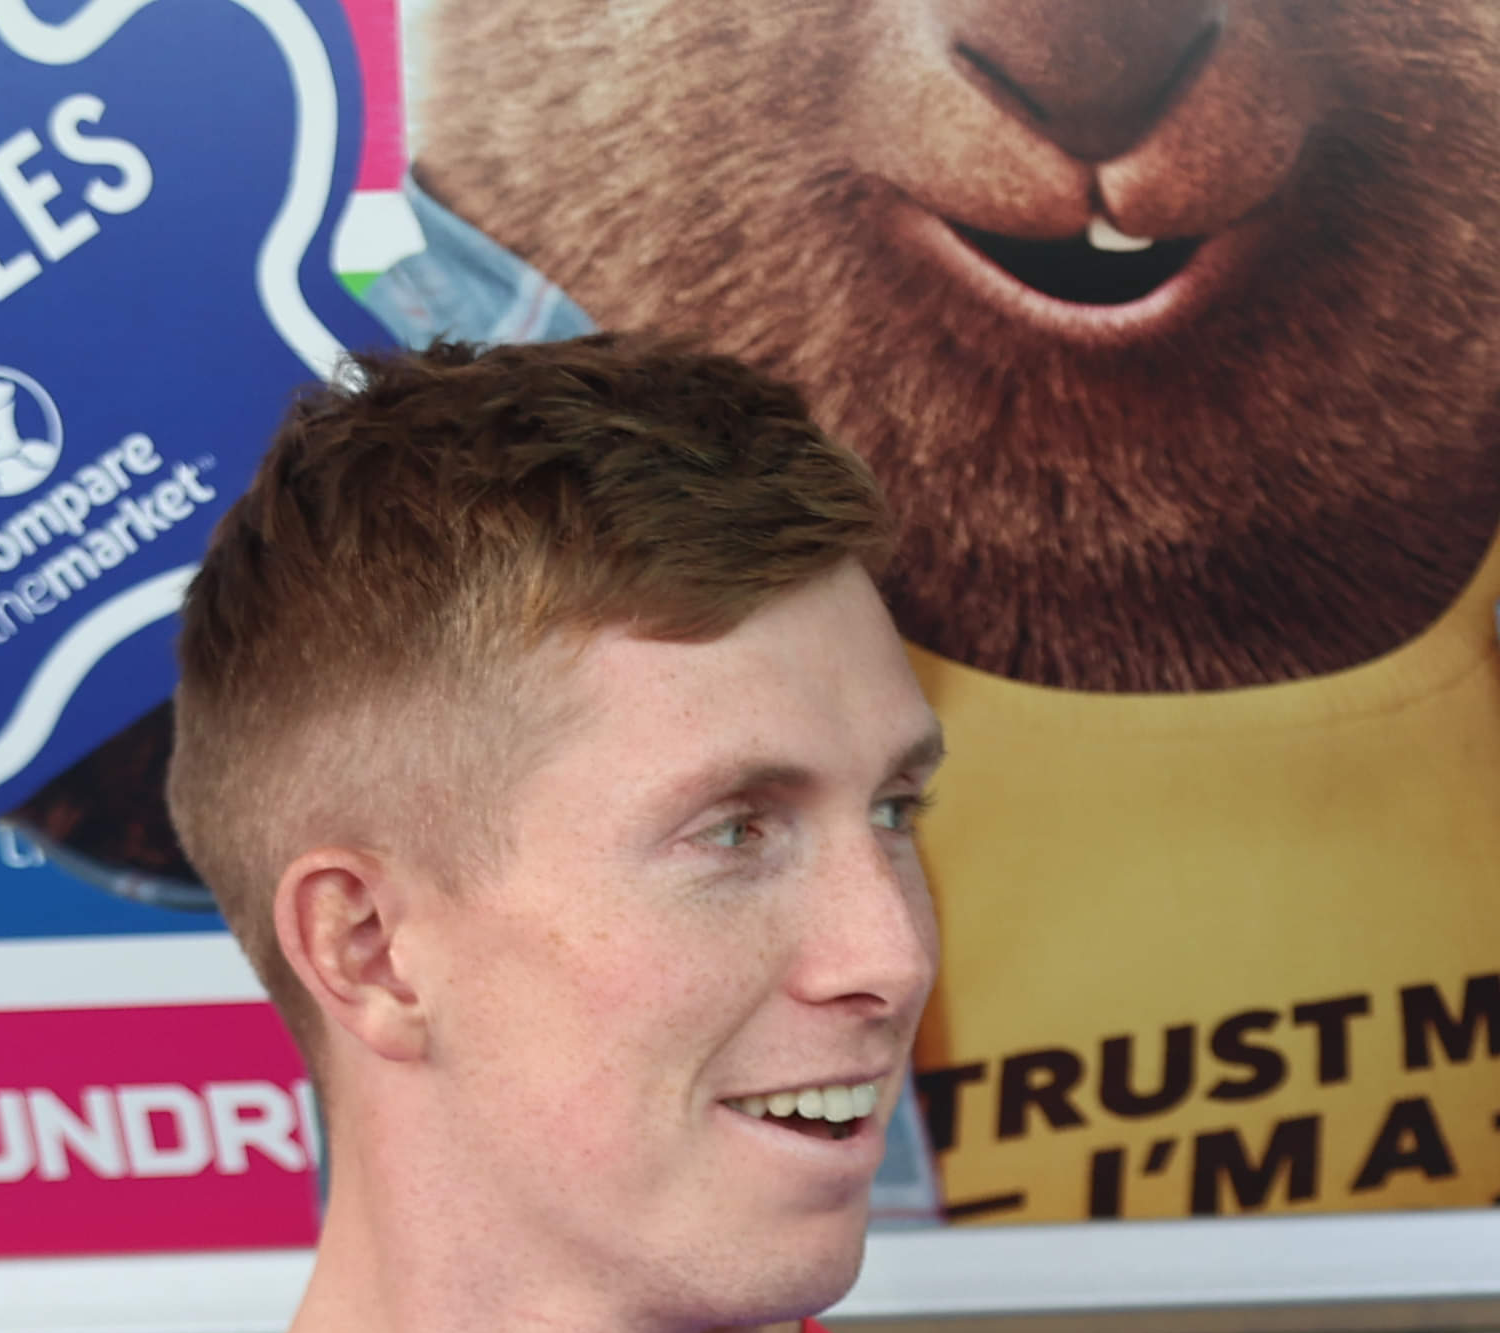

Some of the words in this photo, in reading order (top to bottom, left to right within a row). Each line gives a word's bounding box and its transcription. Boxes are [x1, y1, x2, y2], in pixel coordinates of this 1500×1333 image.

[915, 992, 1372, 1152] TRUST
[1088, 1114, 1322, 1220] I'M
[1350, 1096, 1457, 1193] A
